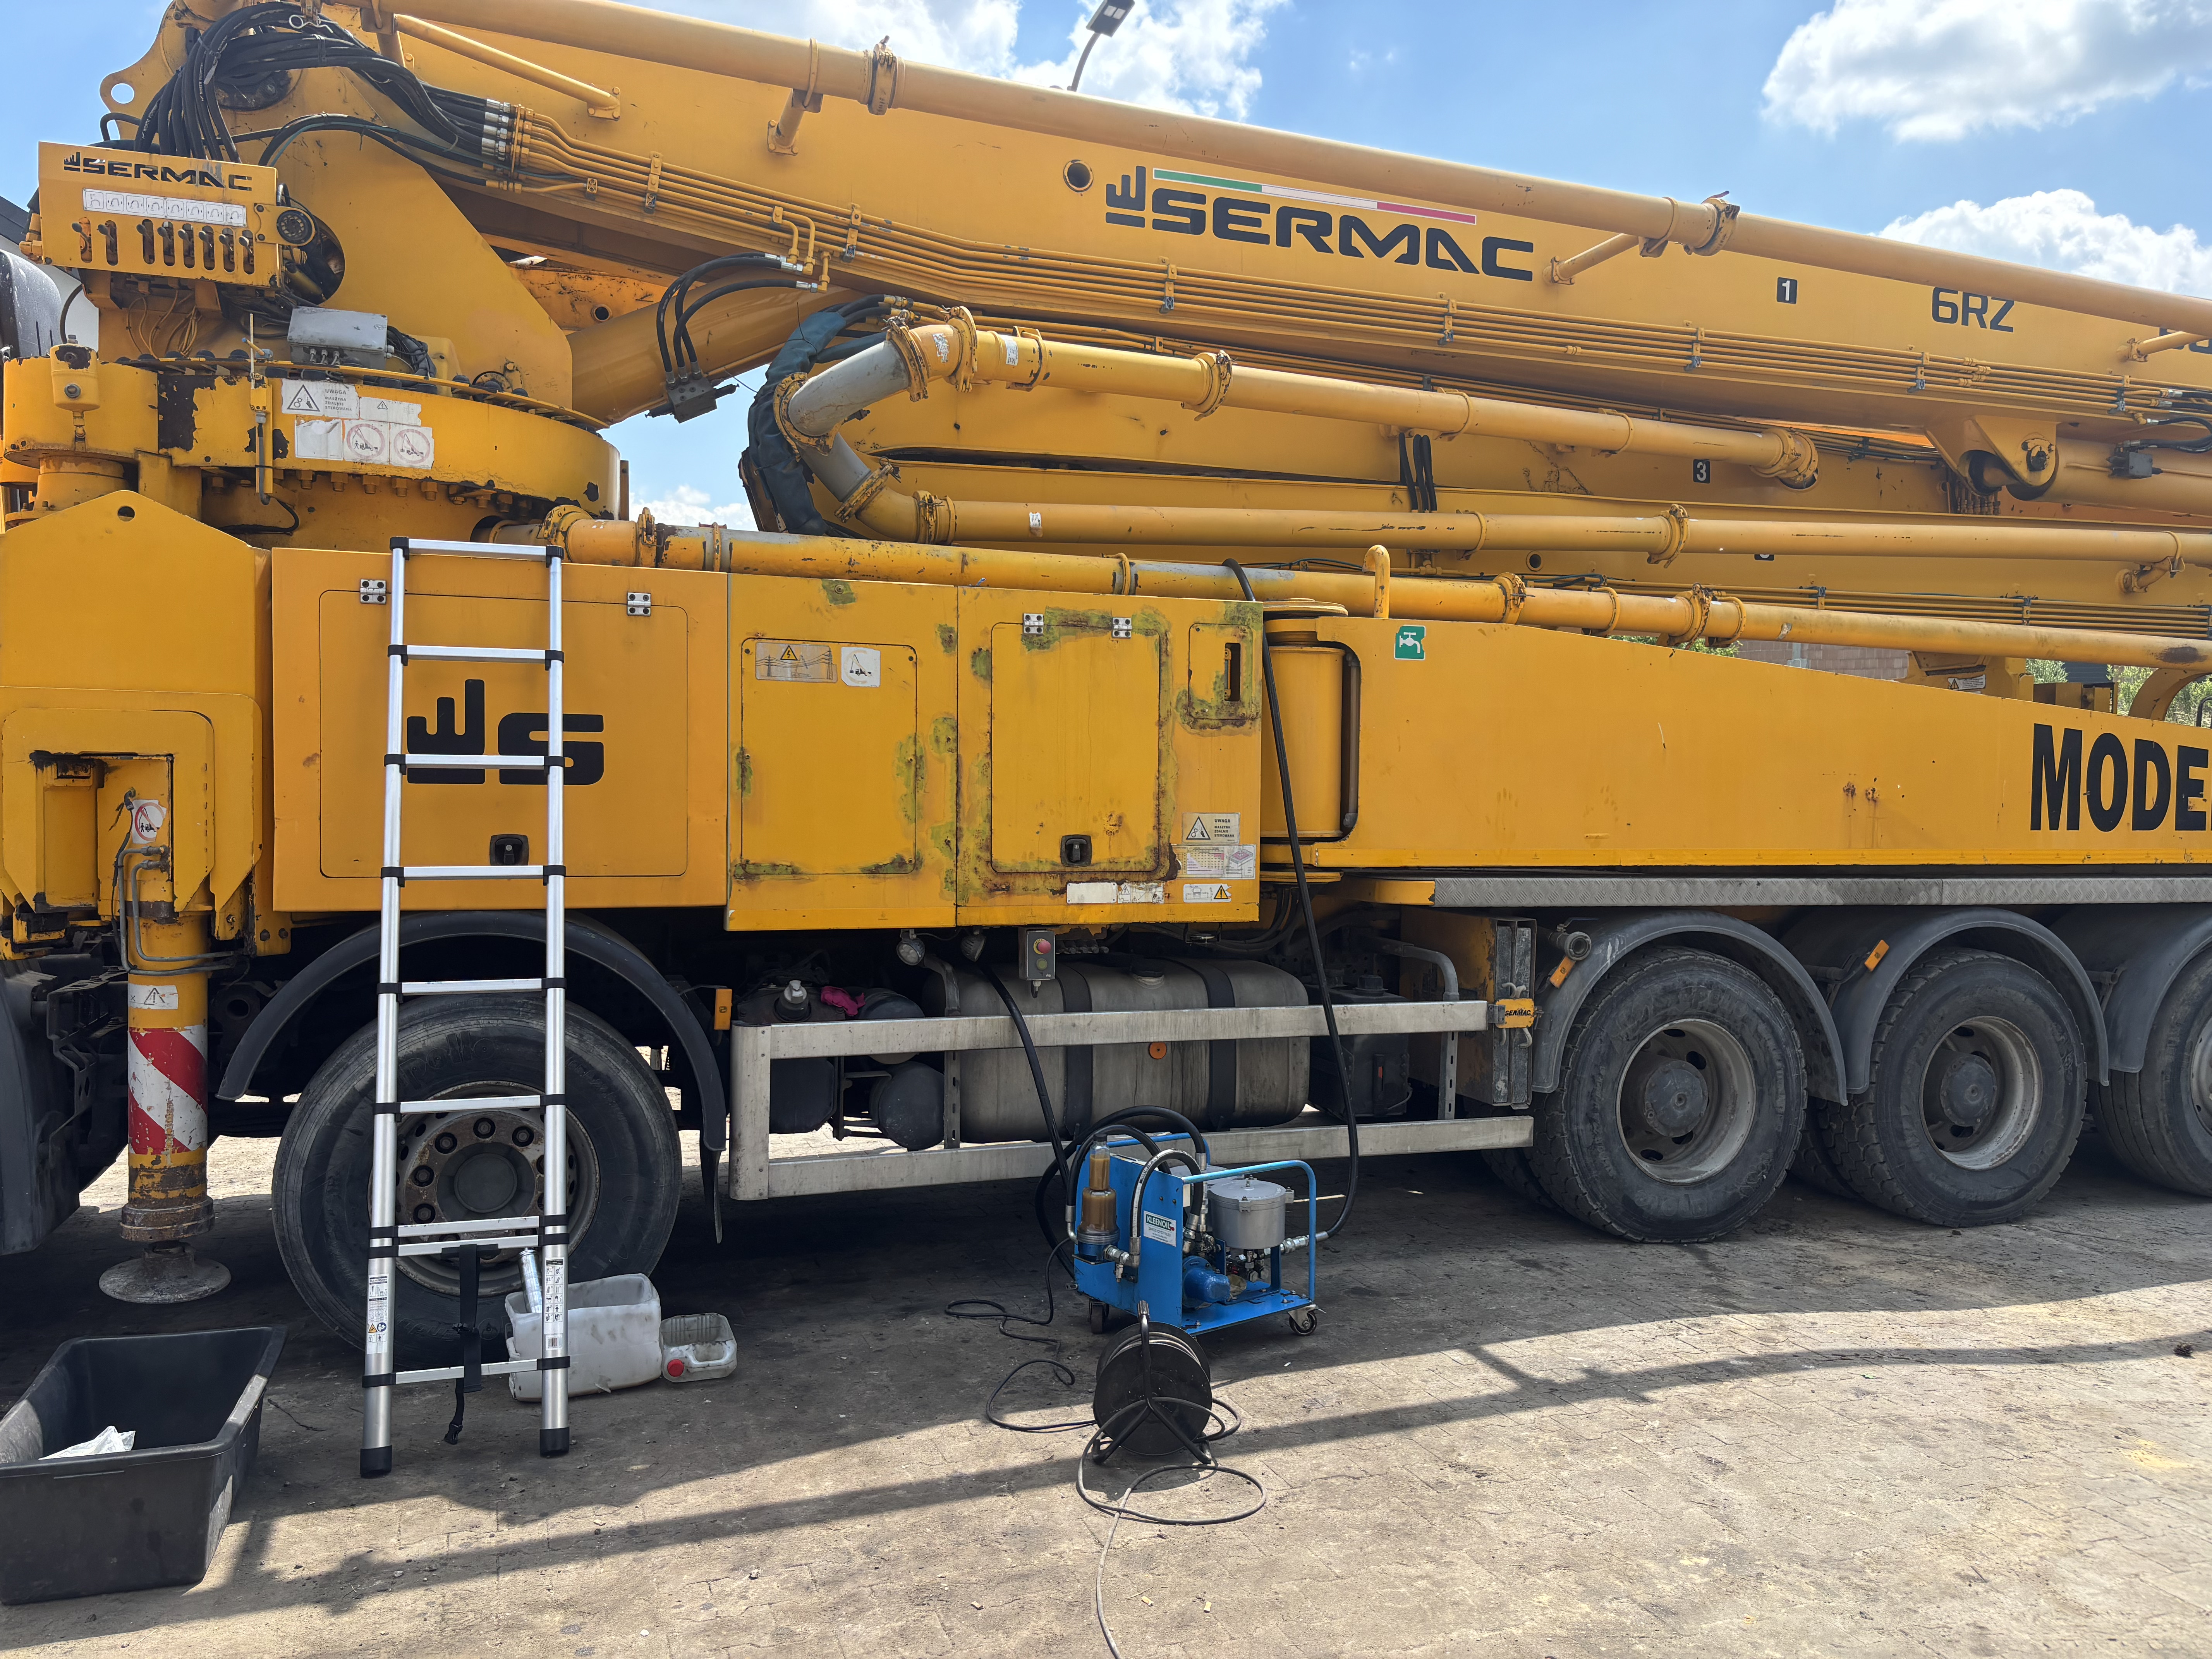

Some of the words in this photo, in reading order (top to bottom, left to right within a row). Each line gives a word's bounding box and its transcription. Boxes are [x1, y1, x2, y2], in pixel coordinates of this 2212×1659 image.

[83, 157, 252, 191] SERMAC
[1151, 187, 1534, 282] SERMAC
[1782, 280, 1790, 301] 1
[1931, 287, 2015, 333] 6RZ
[1697, 462, 1707, 481] 3
[2030, 723, 2212, 832] MODE
[1147, 1215, 1170, 1229] KLEENOIL
